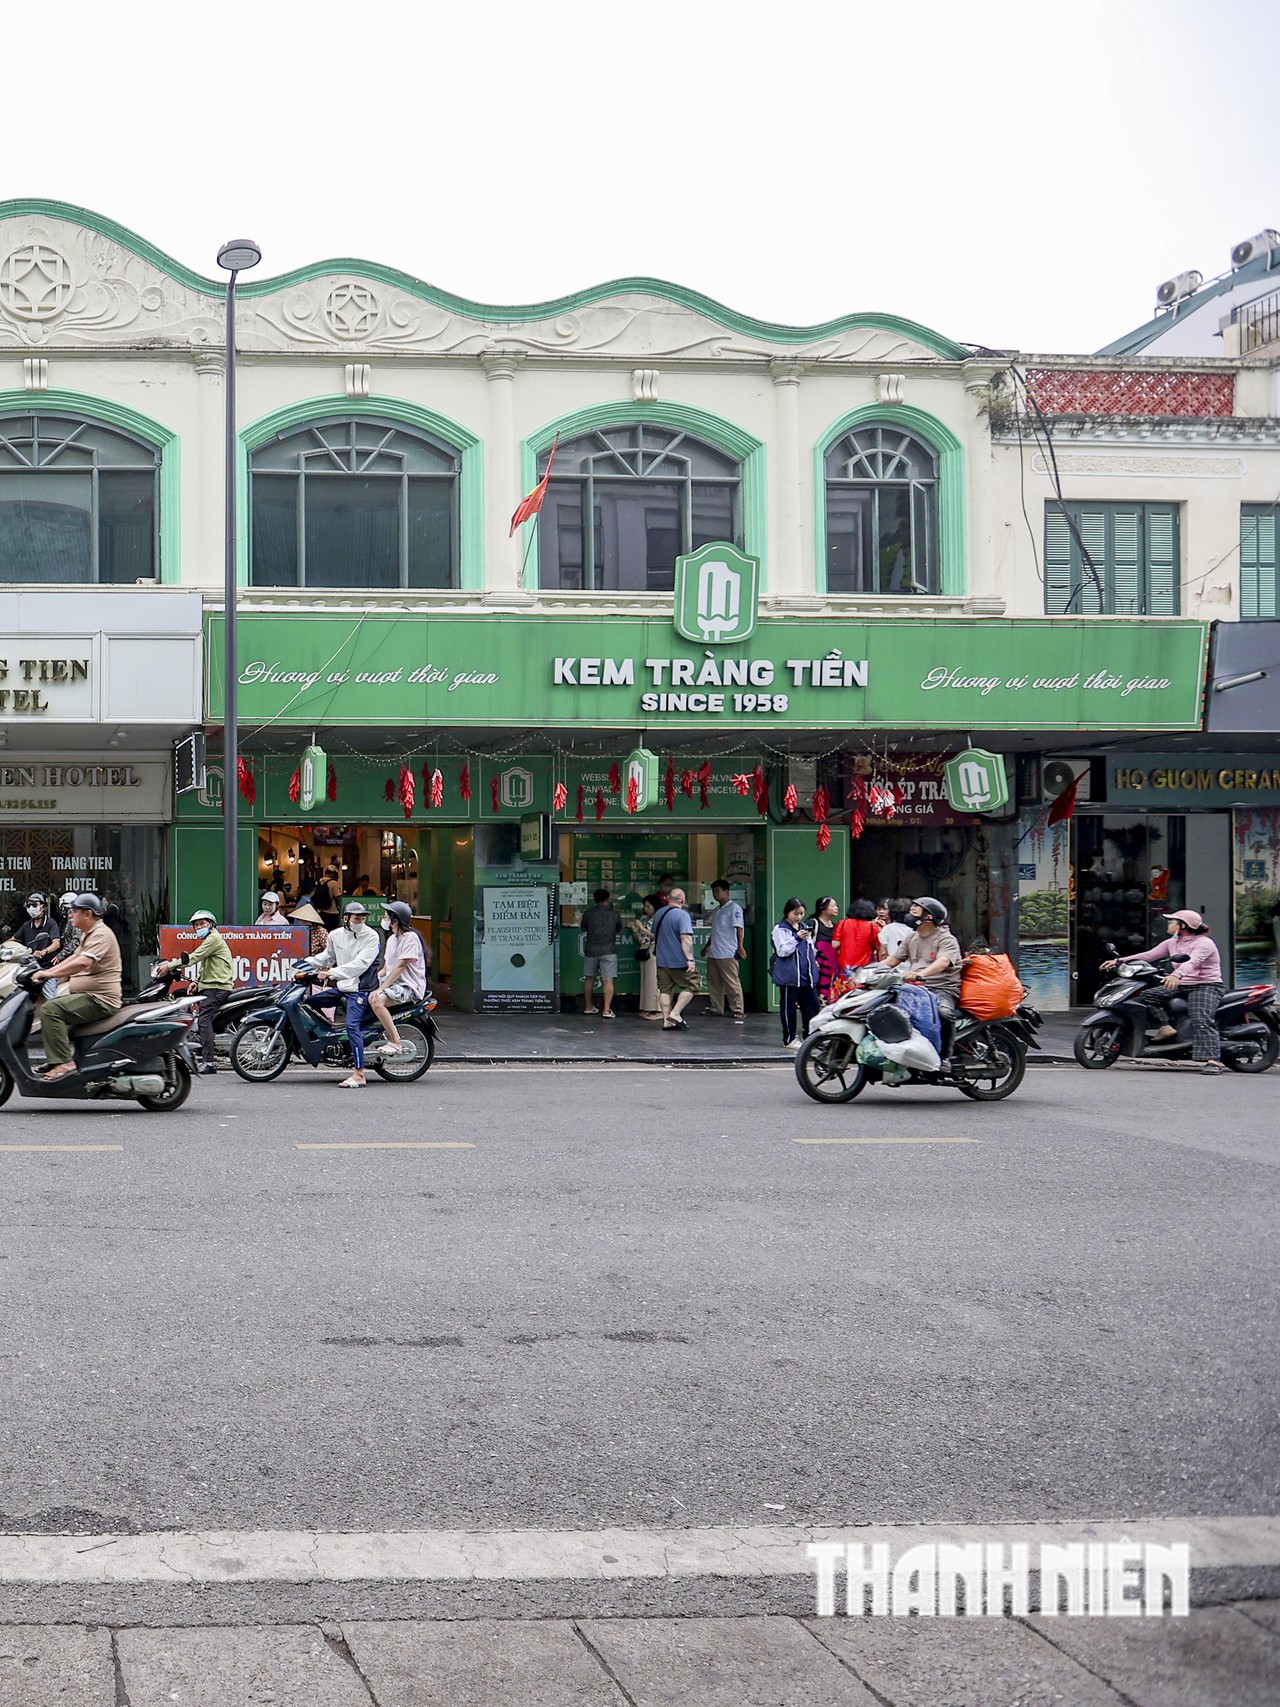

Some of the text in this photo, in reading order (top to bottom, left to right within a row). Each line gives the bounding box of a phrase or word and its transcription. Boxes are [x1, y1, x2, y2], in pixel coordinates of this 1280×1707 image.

[19, 659, 90, 680] TIEN
[553, 648, 869, 687] KEM TRÀNG TIỀN
[448, 670, 500, 691] gian
[1005, 674, 1029, 691] vị
[1120, 675, 1172, 697] gian
[641, 693, 789, 713] SINCE 1958
[43, 766, 140, 787] HOTEL
[581, 773, 621, 782] WEBSI
[1150, 768, 1213, 789] GUOM
[919, 776, 949, 800] TRÁ
[915, 803, 934, 814] GIÁ
[6, 856, 32, 870] TIEN
[51, 856, 113, 870] TRANG TIEN
[65, 878, 98, 891] HOTEL
[493, 899, 540, 911] TẠM BIỆT
[176, 931, 198, 940] CÔNG
[220, 931, 245, 940] ƯỜNG
[245, 931, 272, 940] TRÀNG
[615, 935, 633, 945] EM
